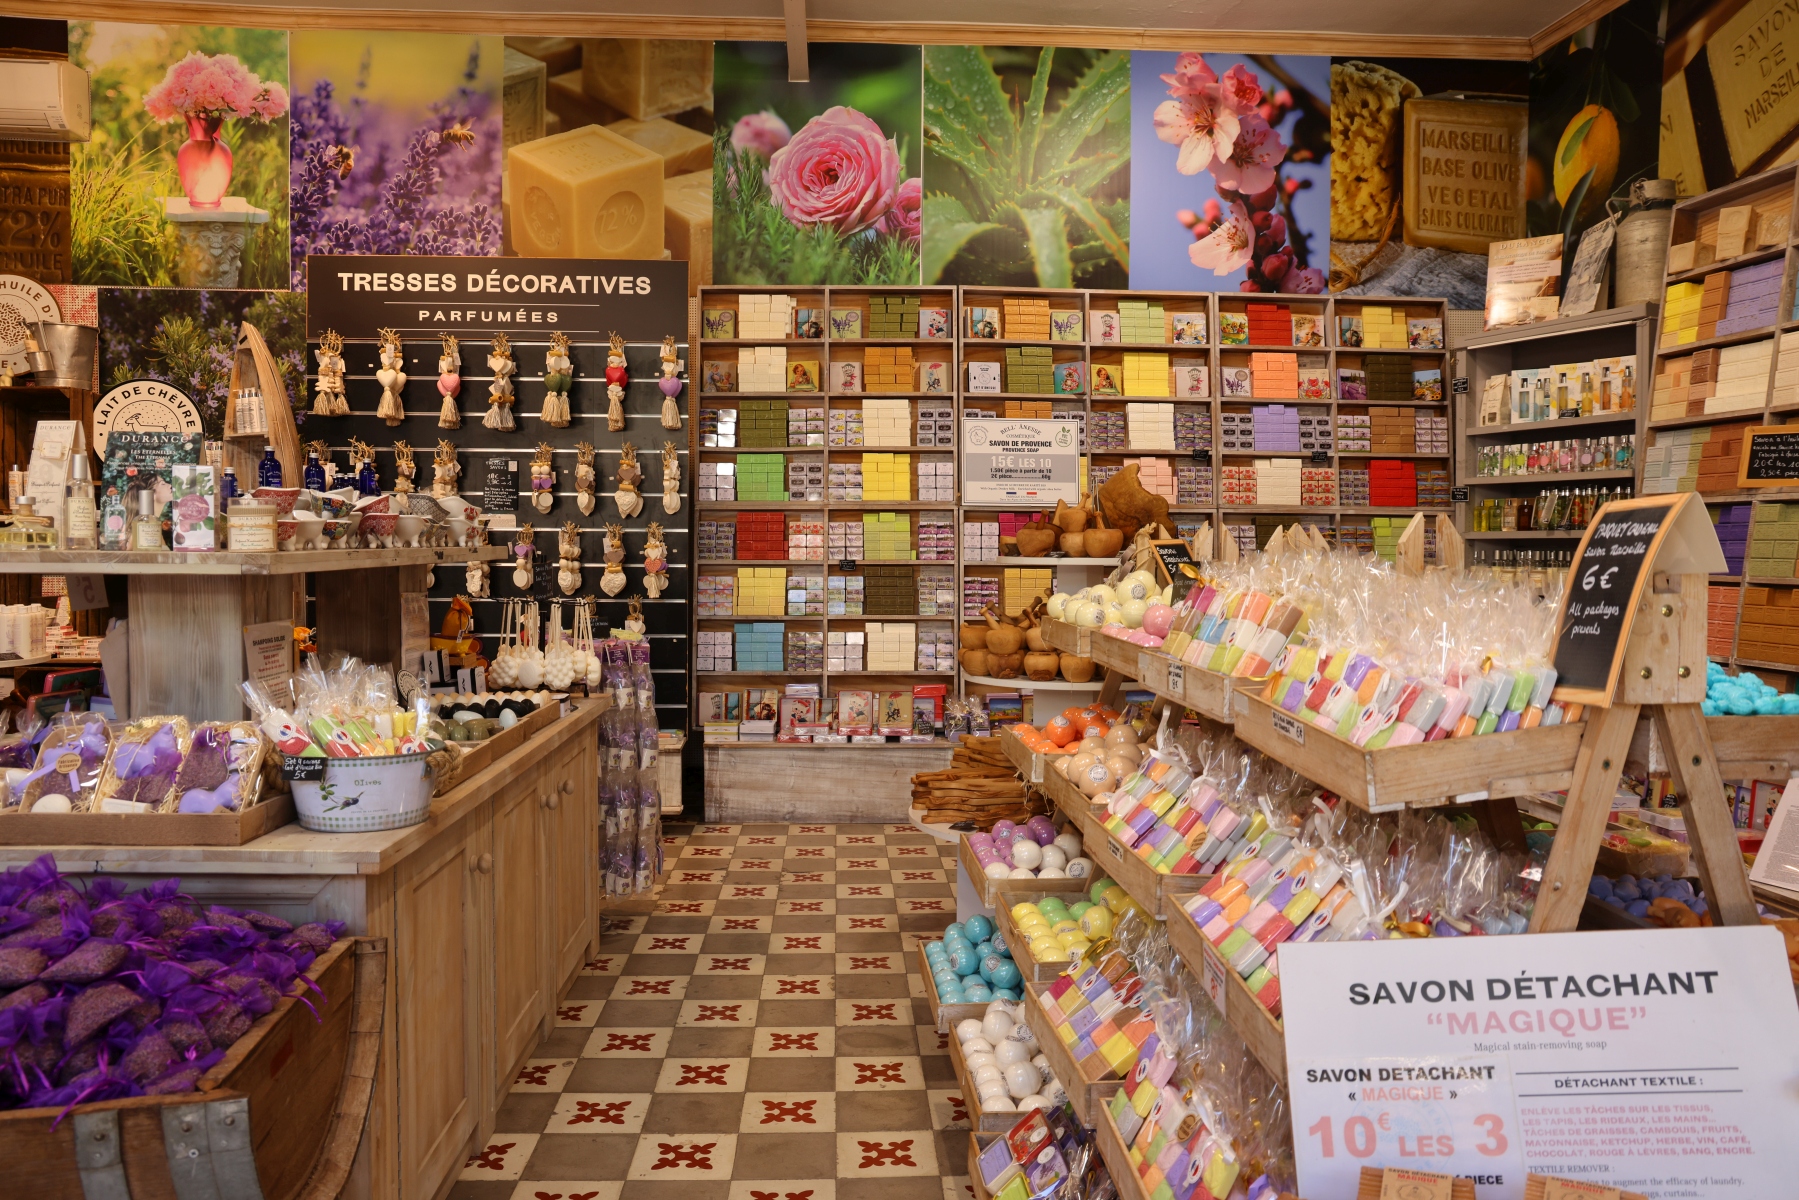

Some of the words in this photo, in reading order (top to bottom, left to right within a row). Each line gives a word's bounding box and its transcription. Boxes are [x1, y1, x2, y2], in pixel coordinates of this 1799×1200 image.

[1758, 42, 1786, 78] DE
[1422, 128, 1519, 154] MARSEILLE
[1422, 156, 1466, 178] BASE
[1472, 161, 1519, 182] OLIVE
[1428, 186, 1513, 211] VEGETAL
[1422, 208, 1452, 228] SANS
[1456, 211, 1516, 234] COLORANT
[337, 272, 457, 292] TRESSES
[466, 269, 652, 295] DÉCORATIVES
[418, 308, 559, 323] PARFUMÉES
[96, 396, 120, 426] LAIT
[122, 386, 142, 400] DE
[146, 386, 196, 428] CHÈVRE
[121, 434, 192, 444] DURANCE
[991, 456, 1014, 468] 15€
[1019, 458, 1035, 468] LES
[1040, 458, 1052, 468] 10
[1568, 602, 1581, 616] All
[253, 636, 273, 646] SHAMPOING
[1349, 979, 1475, 1006] SAVON
[1486, 970, 1718, 1000] DÉTACHANT
[1474, 1042, 1510, 1053] Magical
[1513, 1040, 1583, 1051] stain-removing
[1586, 1040, 1607, 1050] soap
[1306, 1069, 1372, 1082] SAVON
[1379, 1066, 1495, 1082] DETACHANT
[1554, 1077, 1637, 1088] DÉTACHANT
[1640, 1076, 1696, 1086] TEXTILE
[1362, 1086, 1444, 1102] MAGIQUE
[1521, 1105, 1560, 1116] ENLÈVE
[1629, 1105, 1649, 1113] SUR
[1673, 1105, 1713, 1113] TISSUS,
[1545, 1118, 1576, 1126] TAPIS,
[1600, 1116, 1649, 1125] RIDEAUX,
[1398, 1135, 1455, 1157] LES
[1473, 1113, 1509, 1157] 3
[1584, 1127, 1638, 1136] GRAISSES,
[1640, 1126, 1700, 1134] CAMBOUIS,
[1702, 1126, 1742, 1134] FRUITS,
[1525, 1139, 1598, 1147] MAYONNAISE,
[1656, 1137, 1695, 1145] HERBE,
[1696, 1137, 1718, 1145] VIN,
[1526, 1150, 1587, 1158] CHOCOLAT,
[1589, 1148, 1624, 1156] ROUGE
[1682, 1147, 1714, 1156] SANG,
[1528, 1165, 1565, 1174] TEXTILE
[1568, 1165, 1610, 1173] REMOVER
[1398, 1174, 1438, 1184] MAGIQUE
[1613, 1179, 1648, 1188] augment
[1650, 1177, 1662, 1185] the
[1666, 1177, 1698, 1188] efficacy
[1700, 1176, 1708, 1185] of
[1711, 1176, 1745, 1187] laundry.
